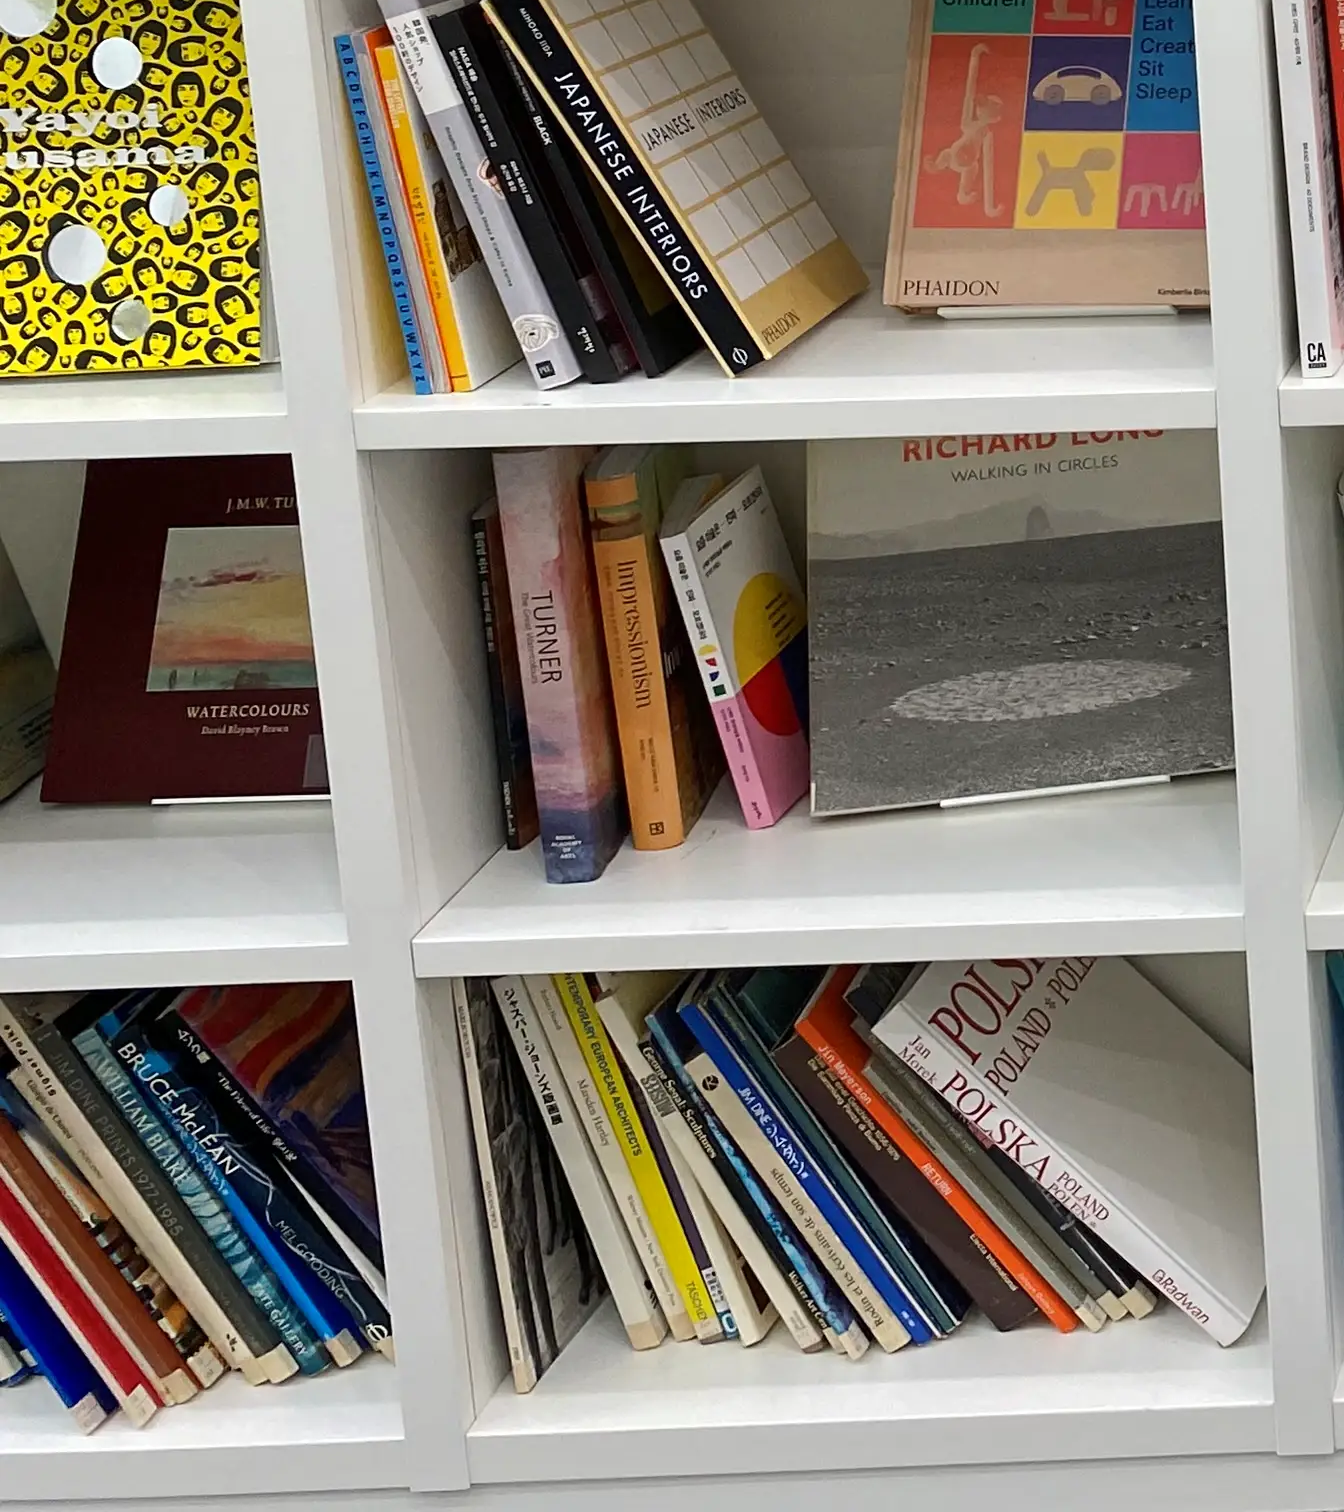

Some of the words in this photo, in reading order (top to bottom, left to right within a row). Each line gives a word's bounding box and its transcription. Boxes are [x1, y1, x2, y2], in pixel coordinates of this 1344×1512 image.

[1142, 15, 1173, 32] Eat
[1138, 61, 1164, 77] Sit
[1136, 84, 1192, 103] Sleep
[0, 102, 163, 139] Yayoi
[531, 115, 553, 146] BLACK
[643, 114, 694, 151] JAPANESE
[696, 89, 747, 125] INTERIORS
[554, 71, 635, 182] JAPANESE
[627, 186, 708, 301] INTERIORS
[903, 280, 1000, 296] PHAIDON
[761, 309, 801, 346] PHAIDON
[1307, 342, 1327, 363] CA
[903, 431, 1057, 462] RICHARD
[951, 464, 1028, 483] WALKING
[1034, 462, 1051, 474] IN
[1058, 455, 1118, 473] CIRCLES
[528, 589, 565, 684] TURNER
[613, 559, 659, 710] Impressionism
[186, 704, 310, 719] WATERCOLOURS
[896, 1043, 941, 1088] Morek
[907, 1033, 936, 1062] Jan
[984, 1005, 1053, 1096] POLAND
[814, 1043, 837, 1066] Jin
[828, 1061, 876, 1108] Mayerson
[117, 1037, 178, 1111] BRUCE
[172, 1096, 240, 1182] McLEAN
[585, 1040, 625, 1096] EUROPEAN
[605, 1093, 650, 1159] ARCHITECTS
[736, 1084, 757, 1107] JIM
[92, 1053, 157, 1138] WILLIAM
[144, 1129, 192, 1189] BLAKE
[682, 1106, 720, 1162] Sculptures
[937, 1066, 1059, 1188] POLSKA
[94, 1113, 138, 1170] PRINTS
[131, 1166, 186, 1239] 1977-1985
[768, 1165, 795, 1200] temps
[918, 1160, 956, 1198] RETURN
[790, 1196, 807, 1216] son
[1055, 1167, 1112, 1225] POLAND
[802, 1213, 819, 1231] de
[274, 1218, 299, 1246] MEL
[293, 1236, 348, 1305] GOODING
[812, 1226, 849, 1276] écrivains
[843, 1271, 861, 1289] les
[853, 1285, 869, 1300] et
[803, 1297, 819, 1315] Art
[860, 1297, 887, 1330] Rodin
[1159, 1274, 1213, 1327] Radwan
[268, 1305, 310, 1359] GALLERY
